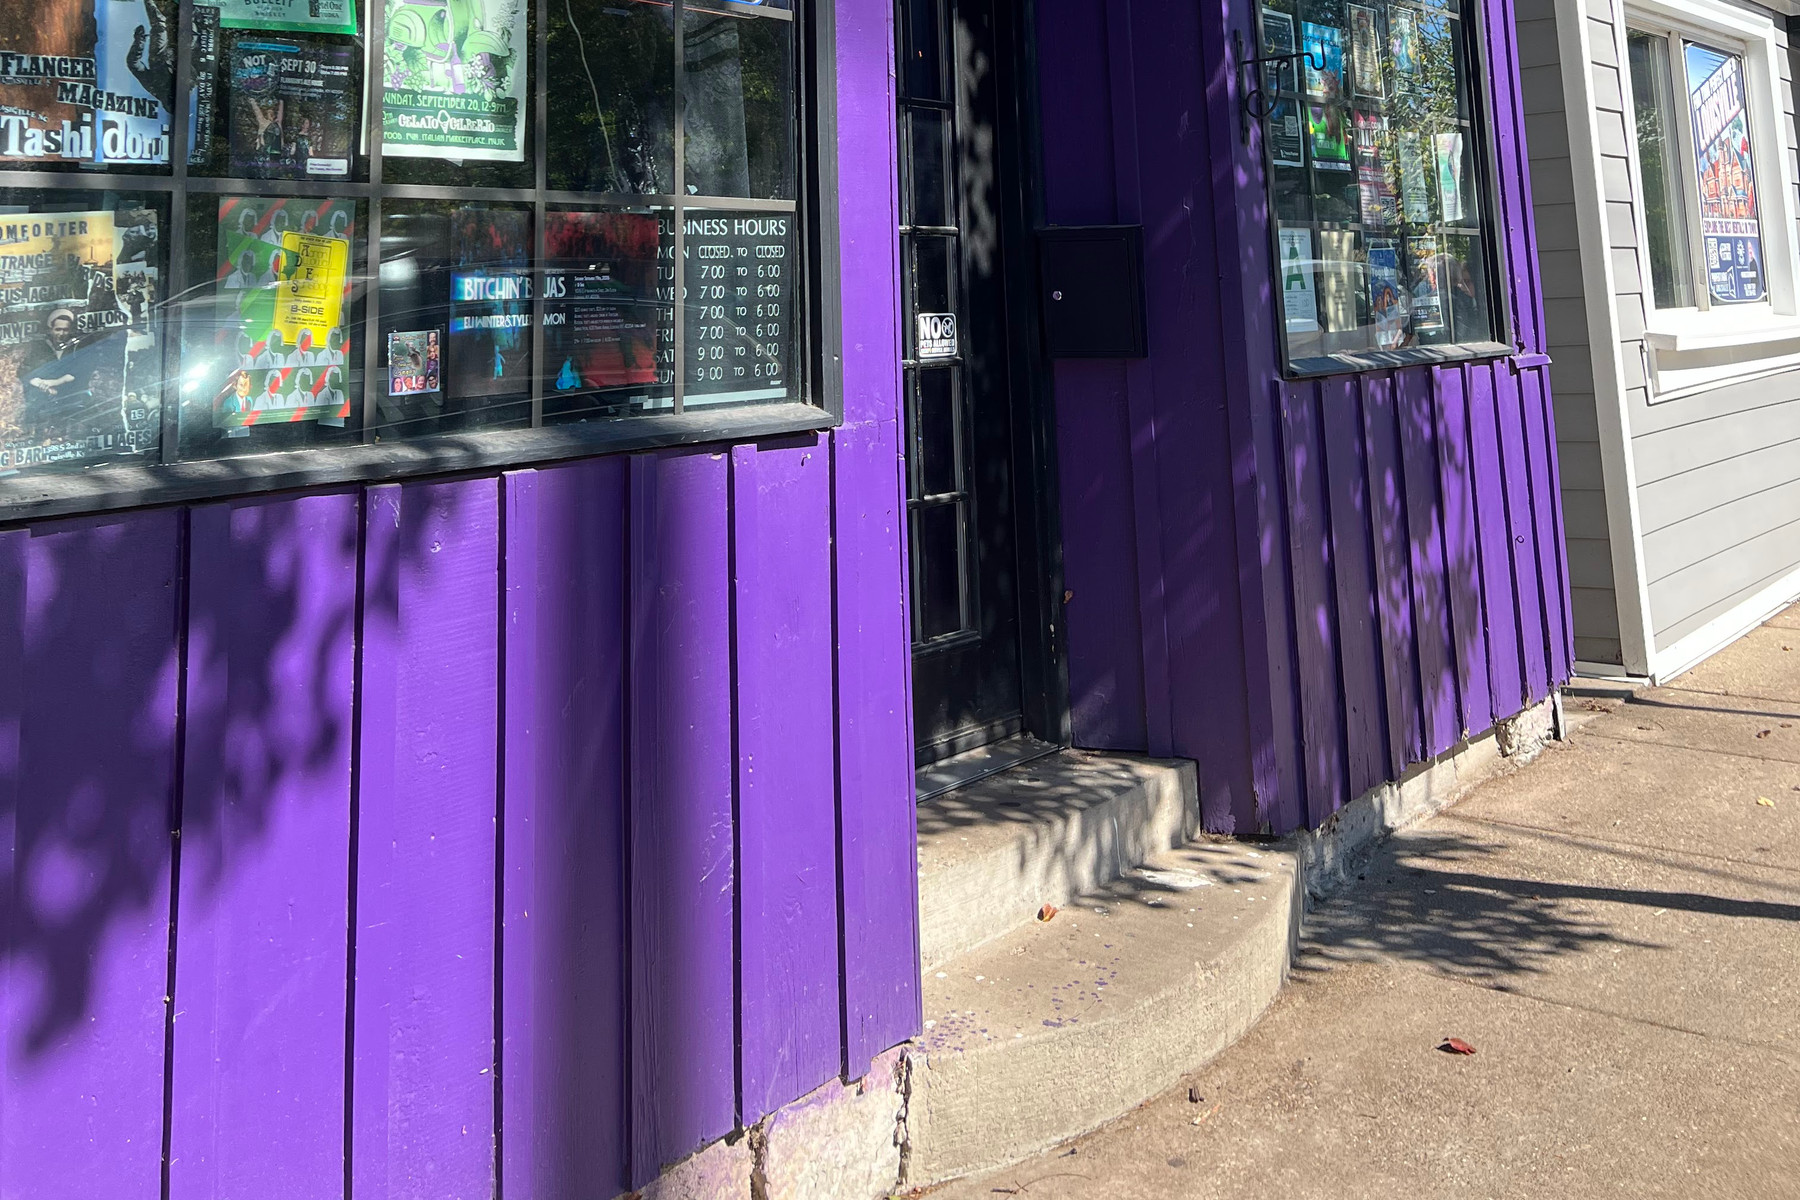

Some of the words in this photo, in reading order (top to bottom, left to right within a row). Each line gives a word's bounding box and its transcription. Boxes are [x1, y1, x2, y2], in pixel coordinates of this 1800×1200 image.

[1, 52, 95, 78] FLANGER
[243, 55, 265, 68] NOT
[281, 58, 303, 72] SEPT
[304, 60, 317, 73] 30
[59, 83, 159, 119] MAGAZINE
[416, 94, 466, 110] SEPTEMBER
[398, 113, 438, 129] GELATO
[1, 113, 93, 159] Tashi
[383, 131, 402, 140] FOOD
[734, 219, 787, 236] HOURS
[736, 247, 748, 257] TO
[755, 245, 785, 259] CLOSED
[736, 267, 748, 277] TO
[1285, 246, 1307, 291] A
[464, 276, 522, 300] BITCHIN'
[736, 287, 748, 296] TO
[290, 304, 324, 316] B-SIDE
[735, 306, 747, 316] TO
[77, 310, 128, 331] SAILOR
[475, 315, 505, 328] WINTER
[920, 316, 942, 339] NO
[655, 328, 674, 342] FRI
[735, 327, 747, 336] TO
[734, 346, 746, 356] TO
[733, 367, 745, 376] TO
[15, 447, 42, 465] BAR
